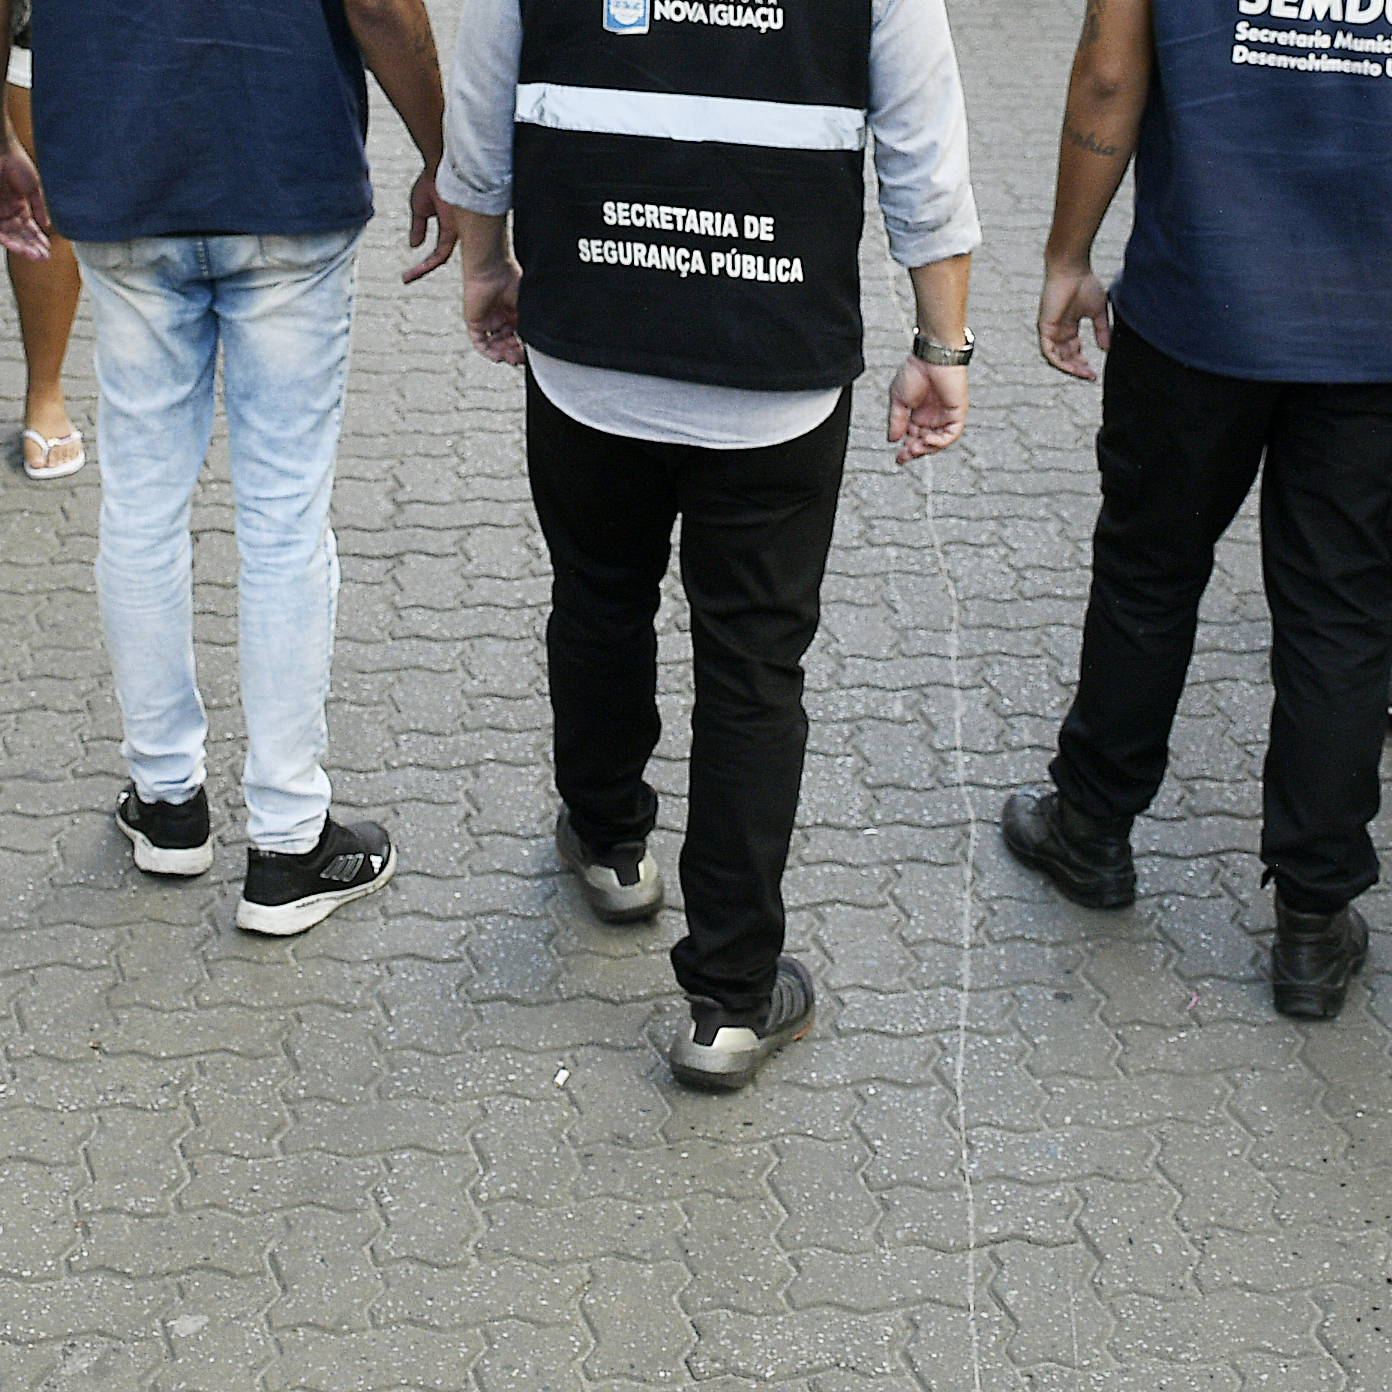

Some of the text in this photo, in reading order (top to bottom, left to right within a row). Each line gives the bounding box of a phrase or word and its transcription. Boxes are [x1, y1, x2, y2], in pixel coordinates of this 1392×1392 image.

[1234, 20, 1332, 50] Secretaria
[1231, 44, 1383, 78] Desenvolvimento
[603, 201, 775, 241] SECRETARIA DE
[578, 238, 804, 283] SEGURANÇA PÚBLICA
